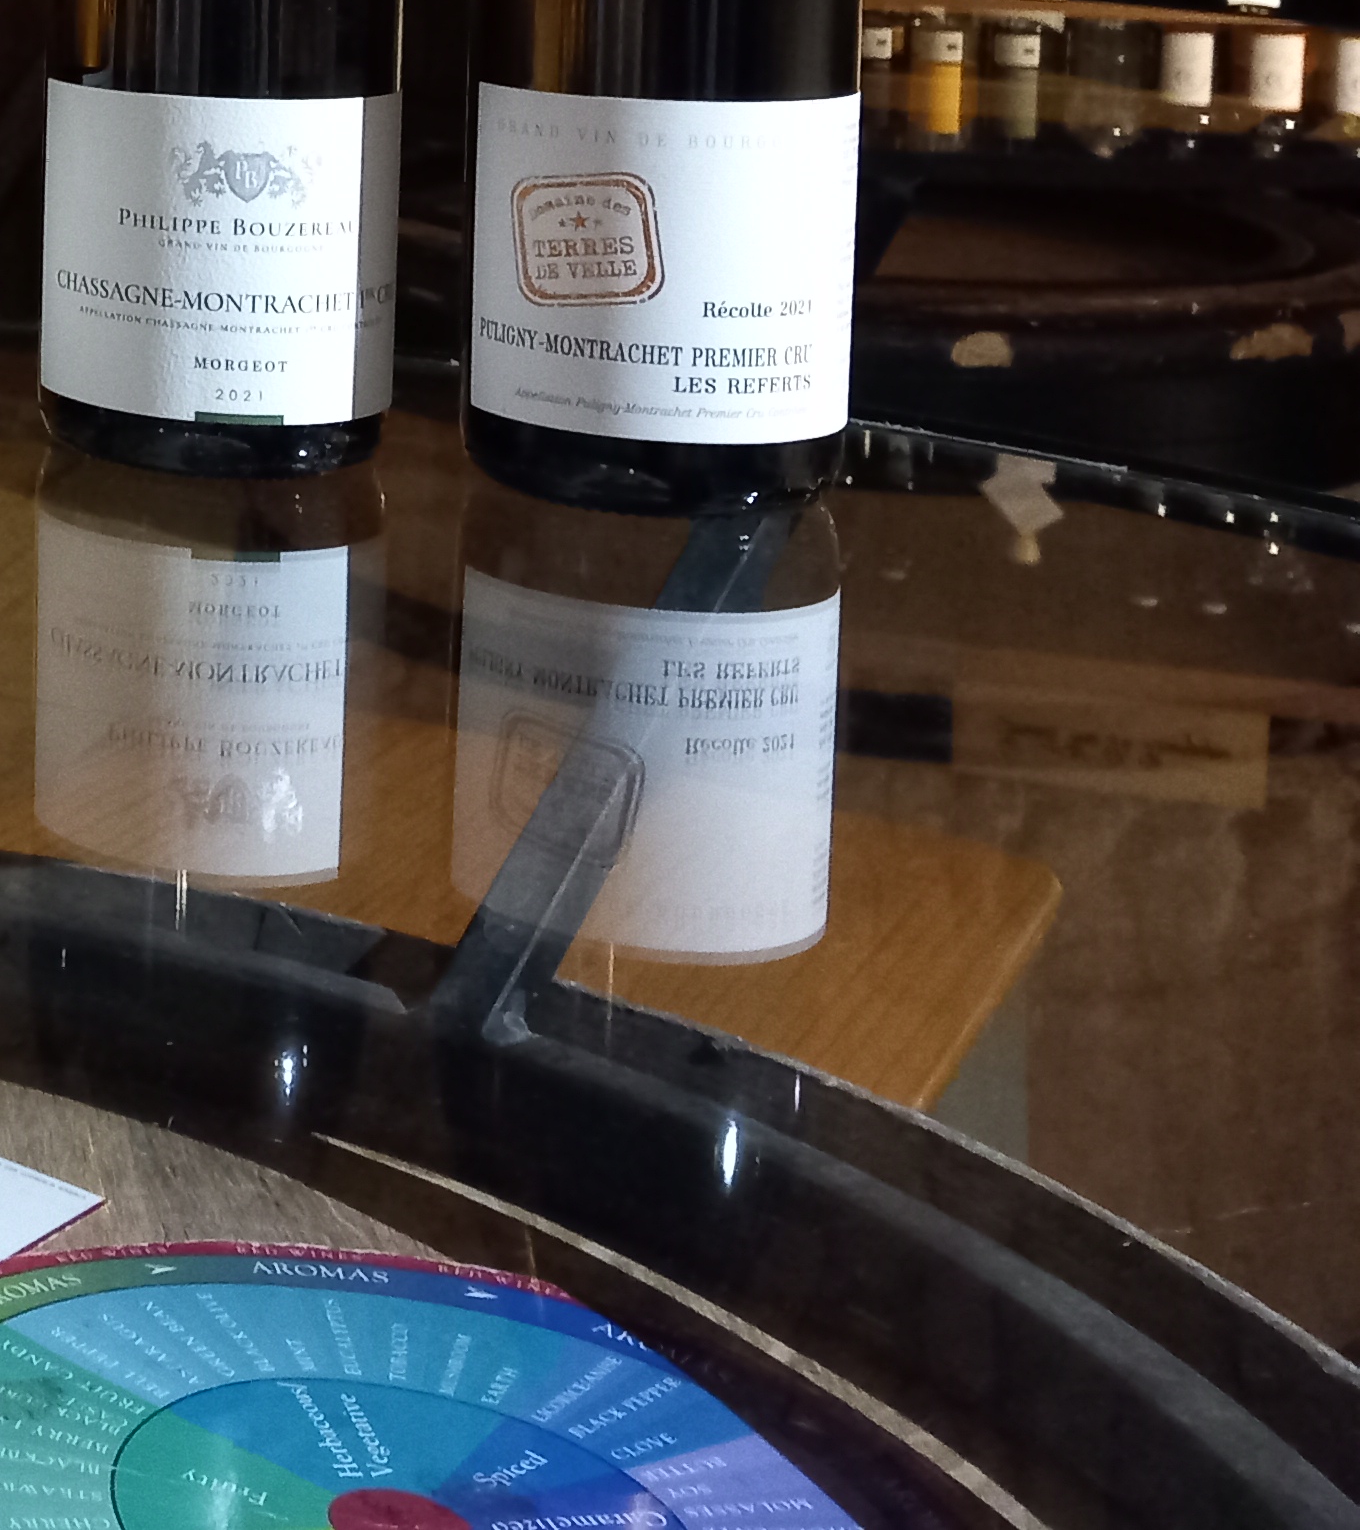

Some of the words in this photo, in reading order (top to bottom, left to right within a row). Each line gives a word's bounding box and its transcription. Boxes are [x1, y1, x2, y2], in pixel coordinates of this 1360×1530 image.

[578, 128, 617, 145] VIN
[639, 132, 668, 149] DE
[118, 207, 222, 236] PHILIPPE
[206, 241, 229, 252] VIN
[233, 242, 249, 253] DE
[533, 235, 636, 259] TERRES
[56, 268, 356, 315] CHASSAGNE-MONTRACHET
[702, 300, 773, 319] Récolte
[479, 315, 684, 367] PULIGNY-MONTRACHET
[691, 346, 778, 368] PREMIER
[193, 356, 289, 373] MORGEOT
[215, 388, 264, 402] 2021
[672, 376, 717, 394] LES
[727, 373, 813, 395] REFERTS
[252, 1260, 390, 1285] AROMAS
[340, 1391, 394, 1479] Vegetative
[567, 1405, 628, 1440] BLACK
[610, 1431, 678, 1461] CLOVE
[472, 1449, 549, 1488] Spiced
[181, 1467, 269, 1507] Fruity
